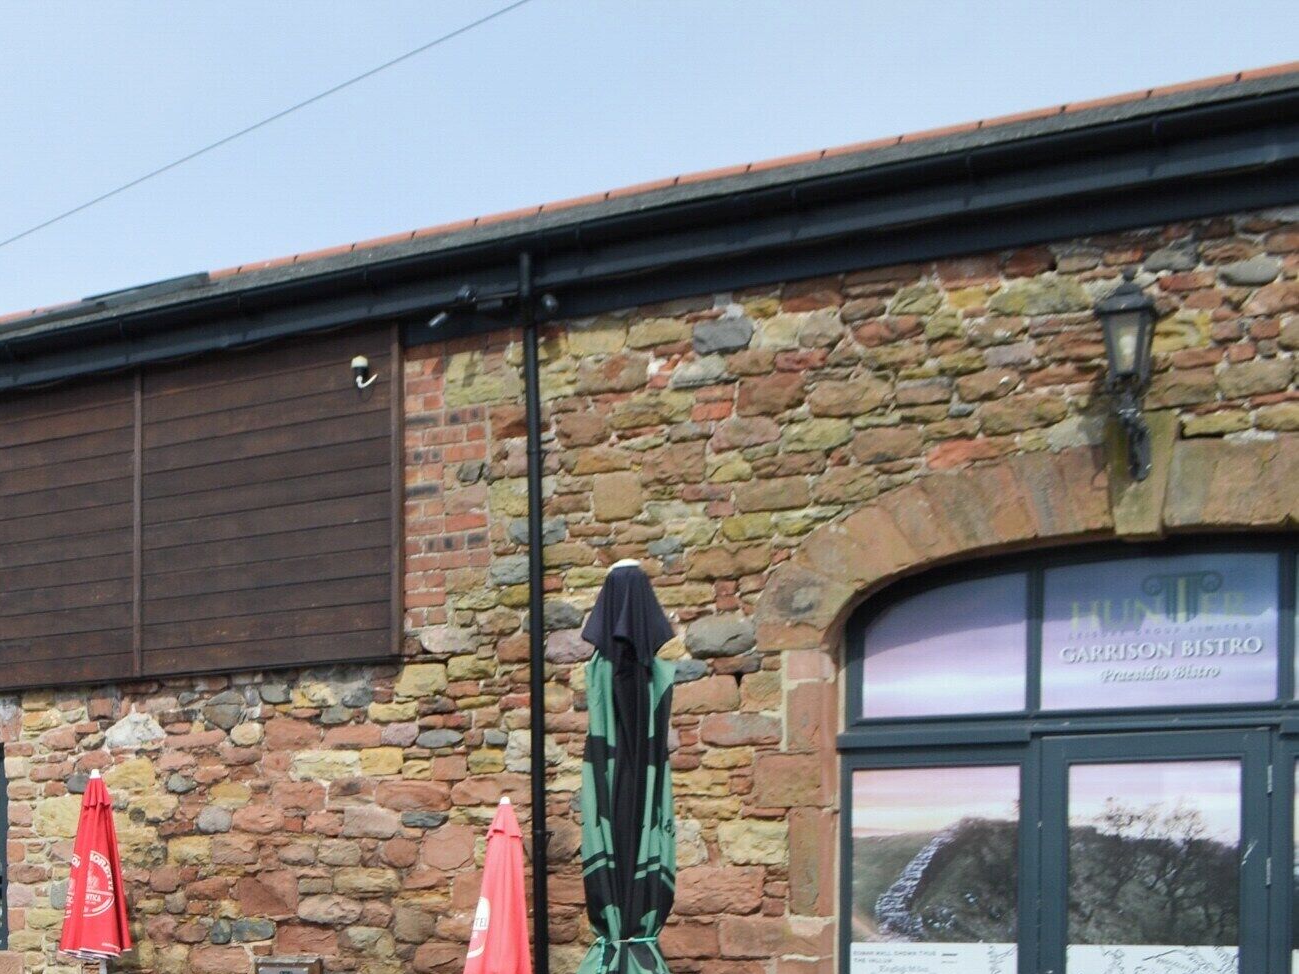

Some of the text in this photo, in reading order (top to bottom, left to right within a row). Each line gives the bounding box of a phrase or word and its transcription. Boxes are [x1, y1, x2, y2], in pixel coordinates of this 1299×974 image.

[1060, 635, 1264, 664] GARRISON BISTRO
[1170, 664, 1221, 680] Bistro
